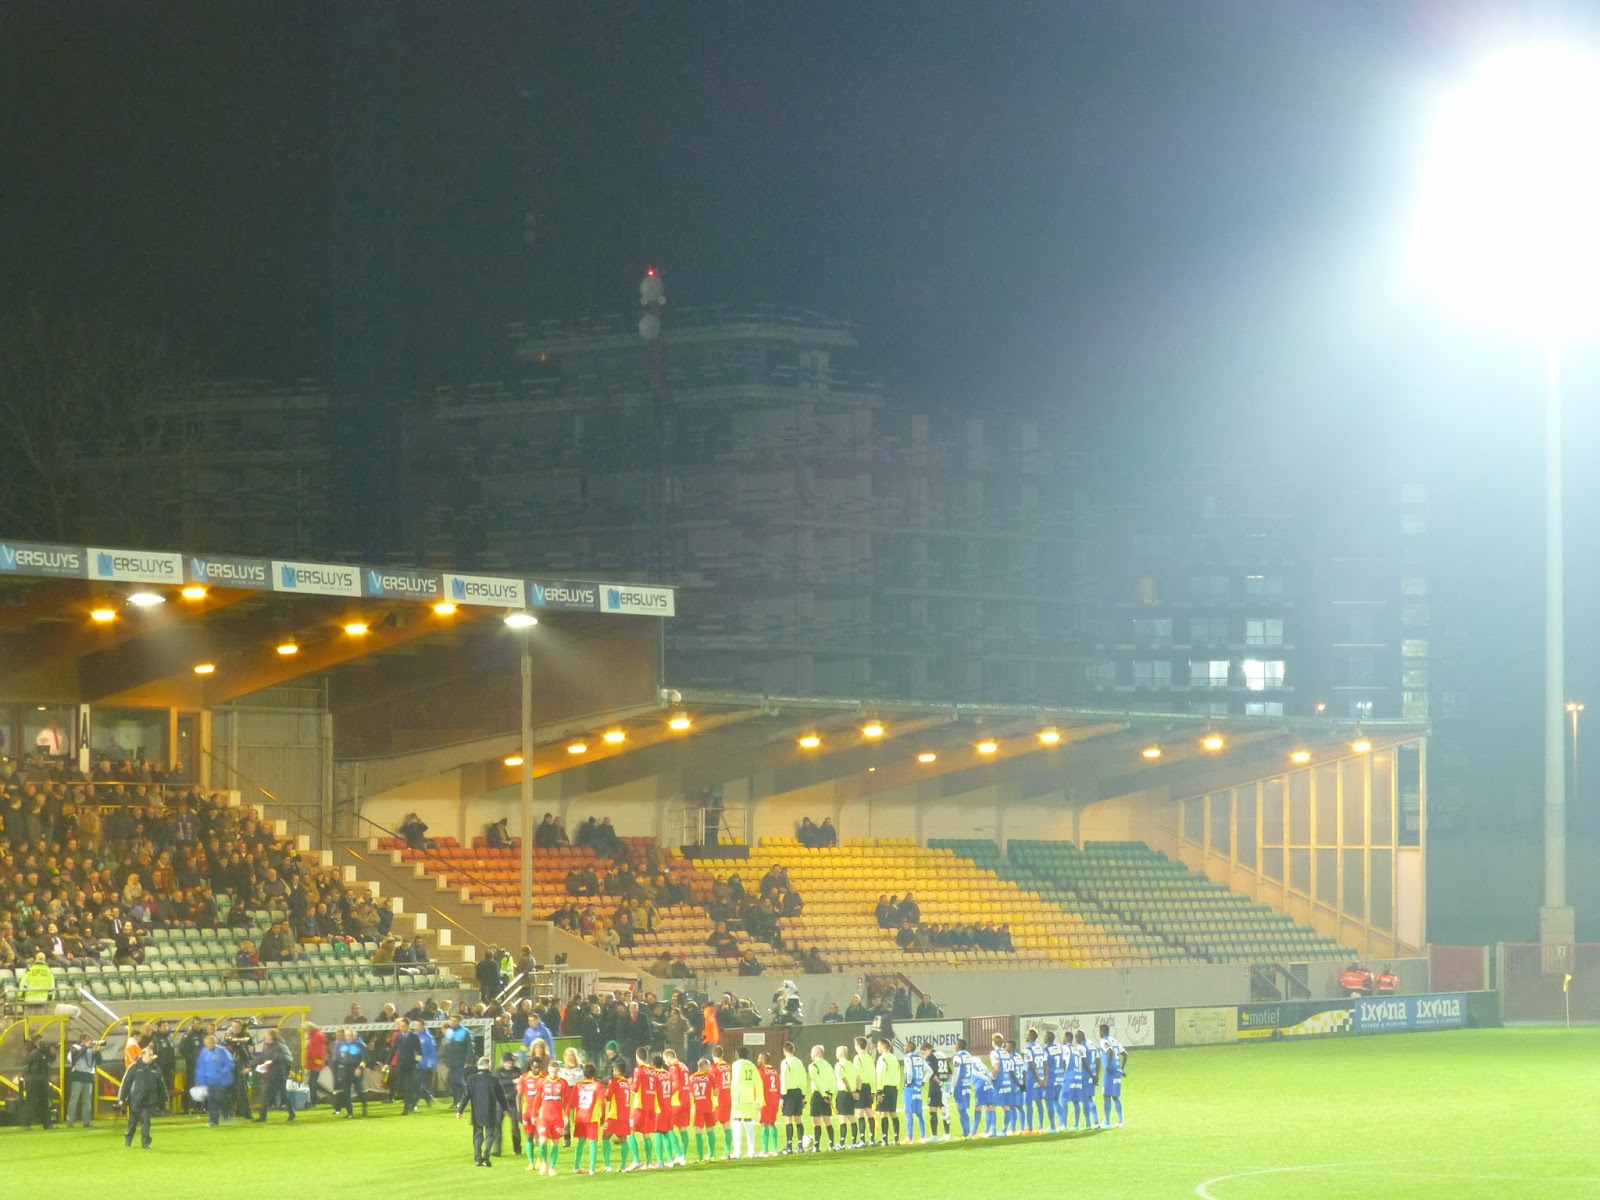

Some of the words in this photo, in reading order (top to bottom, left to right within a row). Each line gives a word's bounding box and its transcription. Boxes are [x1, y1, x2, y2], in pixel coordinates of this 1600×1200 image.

[2, 545, 79, 568] VERSLUYS
[101, 552, 174, 574] VERSLUYS
[193, 557, 265, 580] VERSLUYS
[284, 564, 353, 586] VERSLUYS
[371, 571, 437, 593] VERSLUYS
[454, 578, 518, 598] VERSLUYS
[534, 583, 594, 603] VERSLUYS
[609, 588, 667, 607] VERSLUYS
[1127, 1013, 1148, 1034] Keyte
[745, 1069, 753, 1081] 12
[770, 1075, 776, 1089] 2
[693, 1082, 707, 1097] 27
